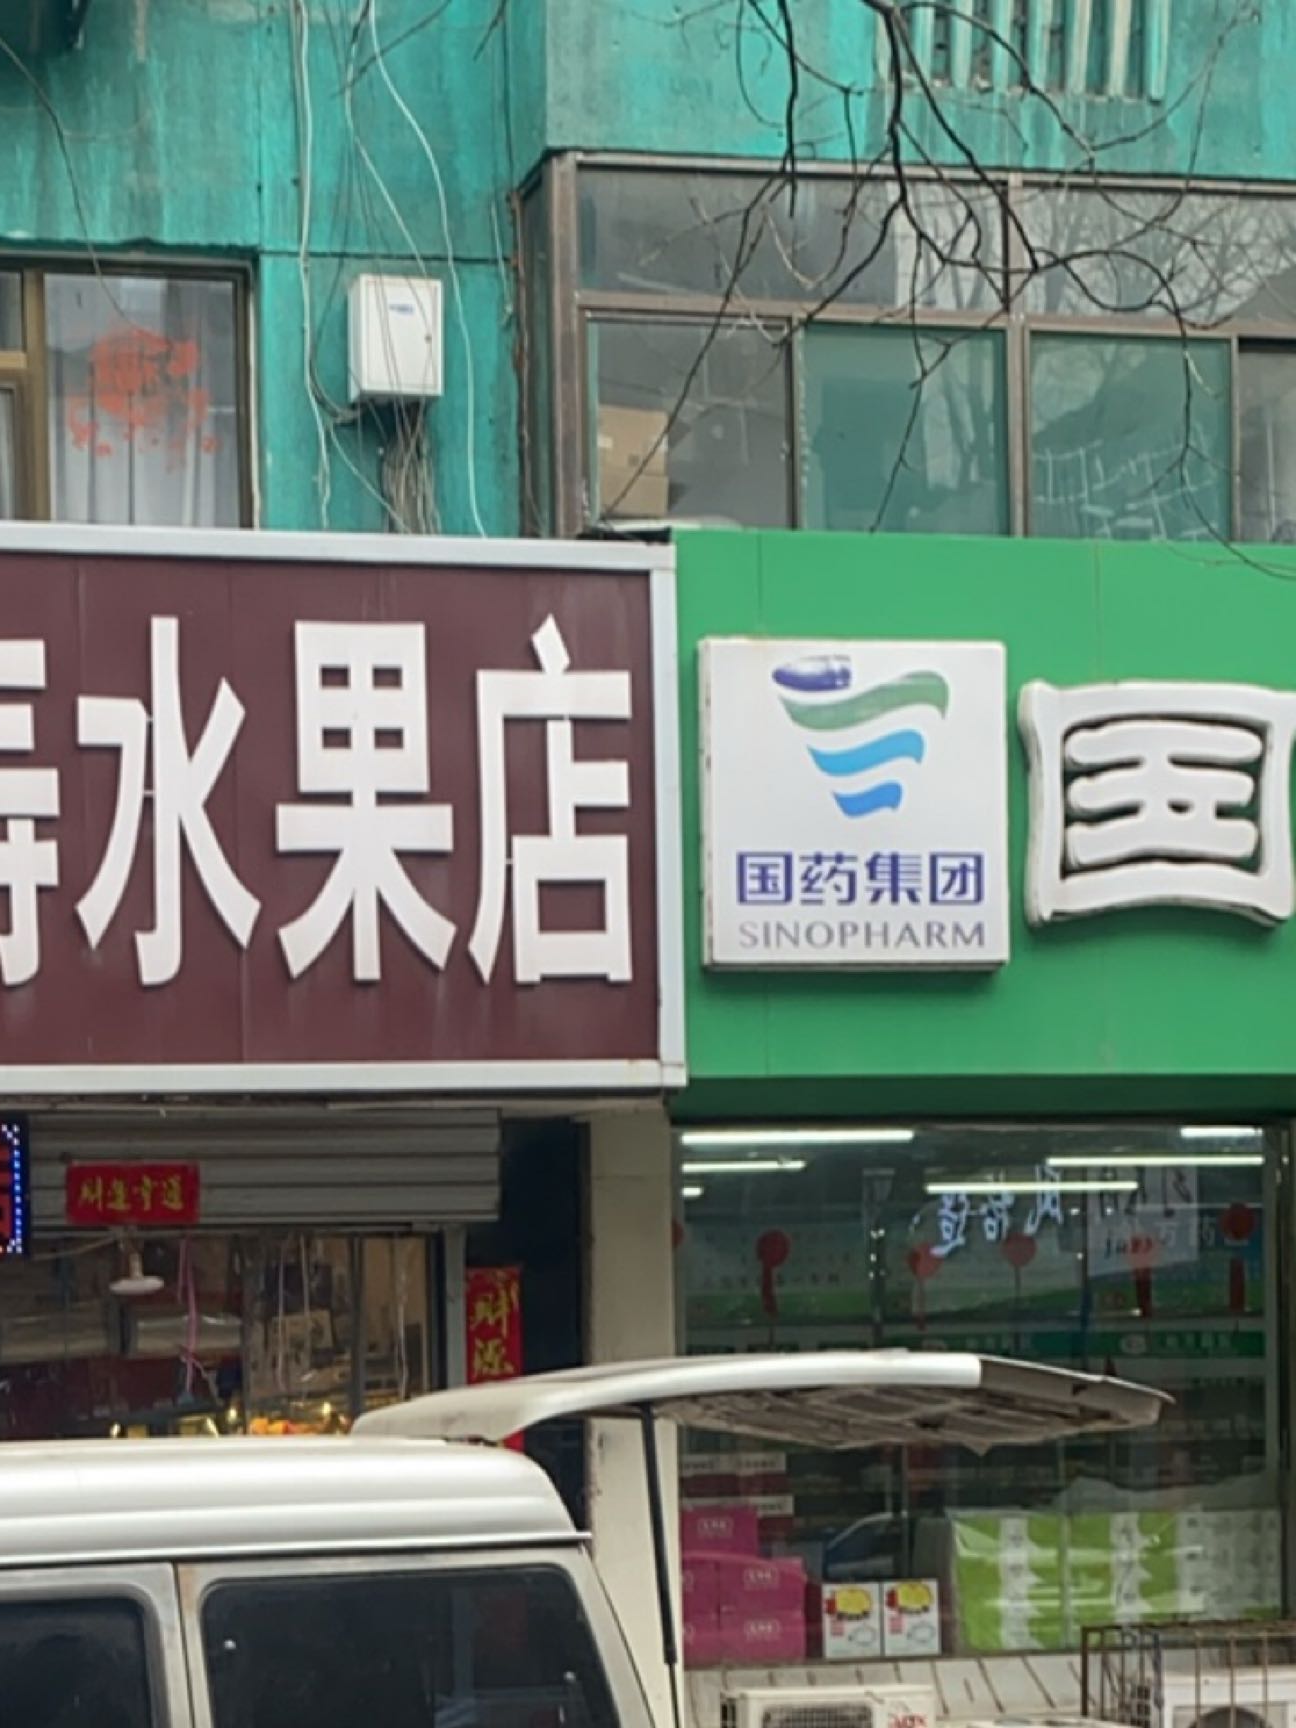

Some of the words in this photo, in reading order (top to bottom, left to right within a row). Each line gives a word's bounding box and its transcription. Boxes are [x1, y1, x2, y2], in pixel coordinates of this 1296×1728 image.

[1019, 679, 1296, 926] 国
[737, 852, 984, 905] 国药集团
[738, 921, 985, 949] SINOPHARM
